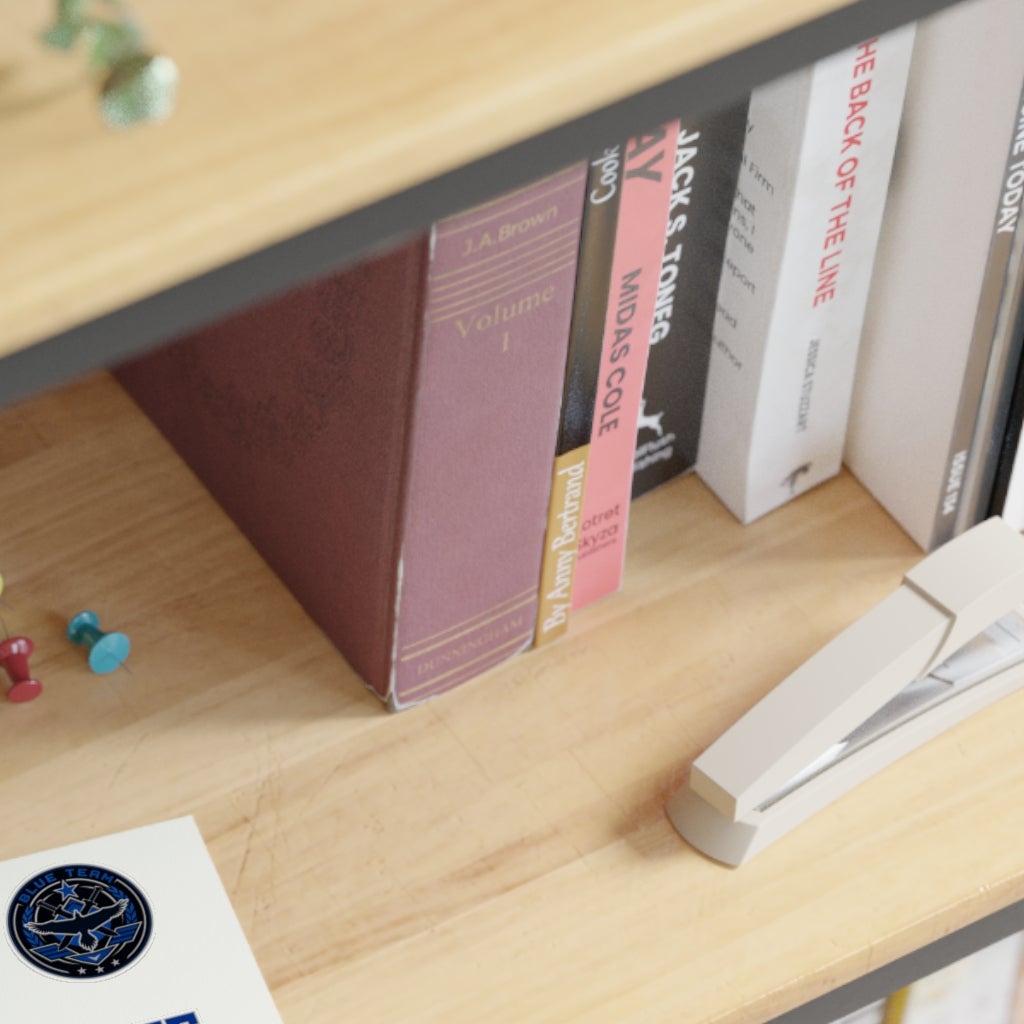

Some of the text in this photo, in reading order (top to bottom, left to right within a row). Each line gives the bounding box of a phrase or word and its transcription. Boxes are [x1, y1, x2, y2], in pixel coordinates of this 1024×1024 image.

[840, 78, 872, 154] BACK
[590, 144, 620, 204] Cook
[669, 129, 701, 212] JACK
[834, 157, 859, 191] OF
[997, 160, 1024, 234] TODAY
[824, 194, 852, 250] THE
[812, 250, 842, 309] LINE
[454, 286, 556, 338] Volume
[598, 267, 643, 438] MIDAS COLE
[551, 460, 585, 551] Bertrand
[542, 602, 572, 634] By
[18, 867, 115, 904] BLUE TEAM
